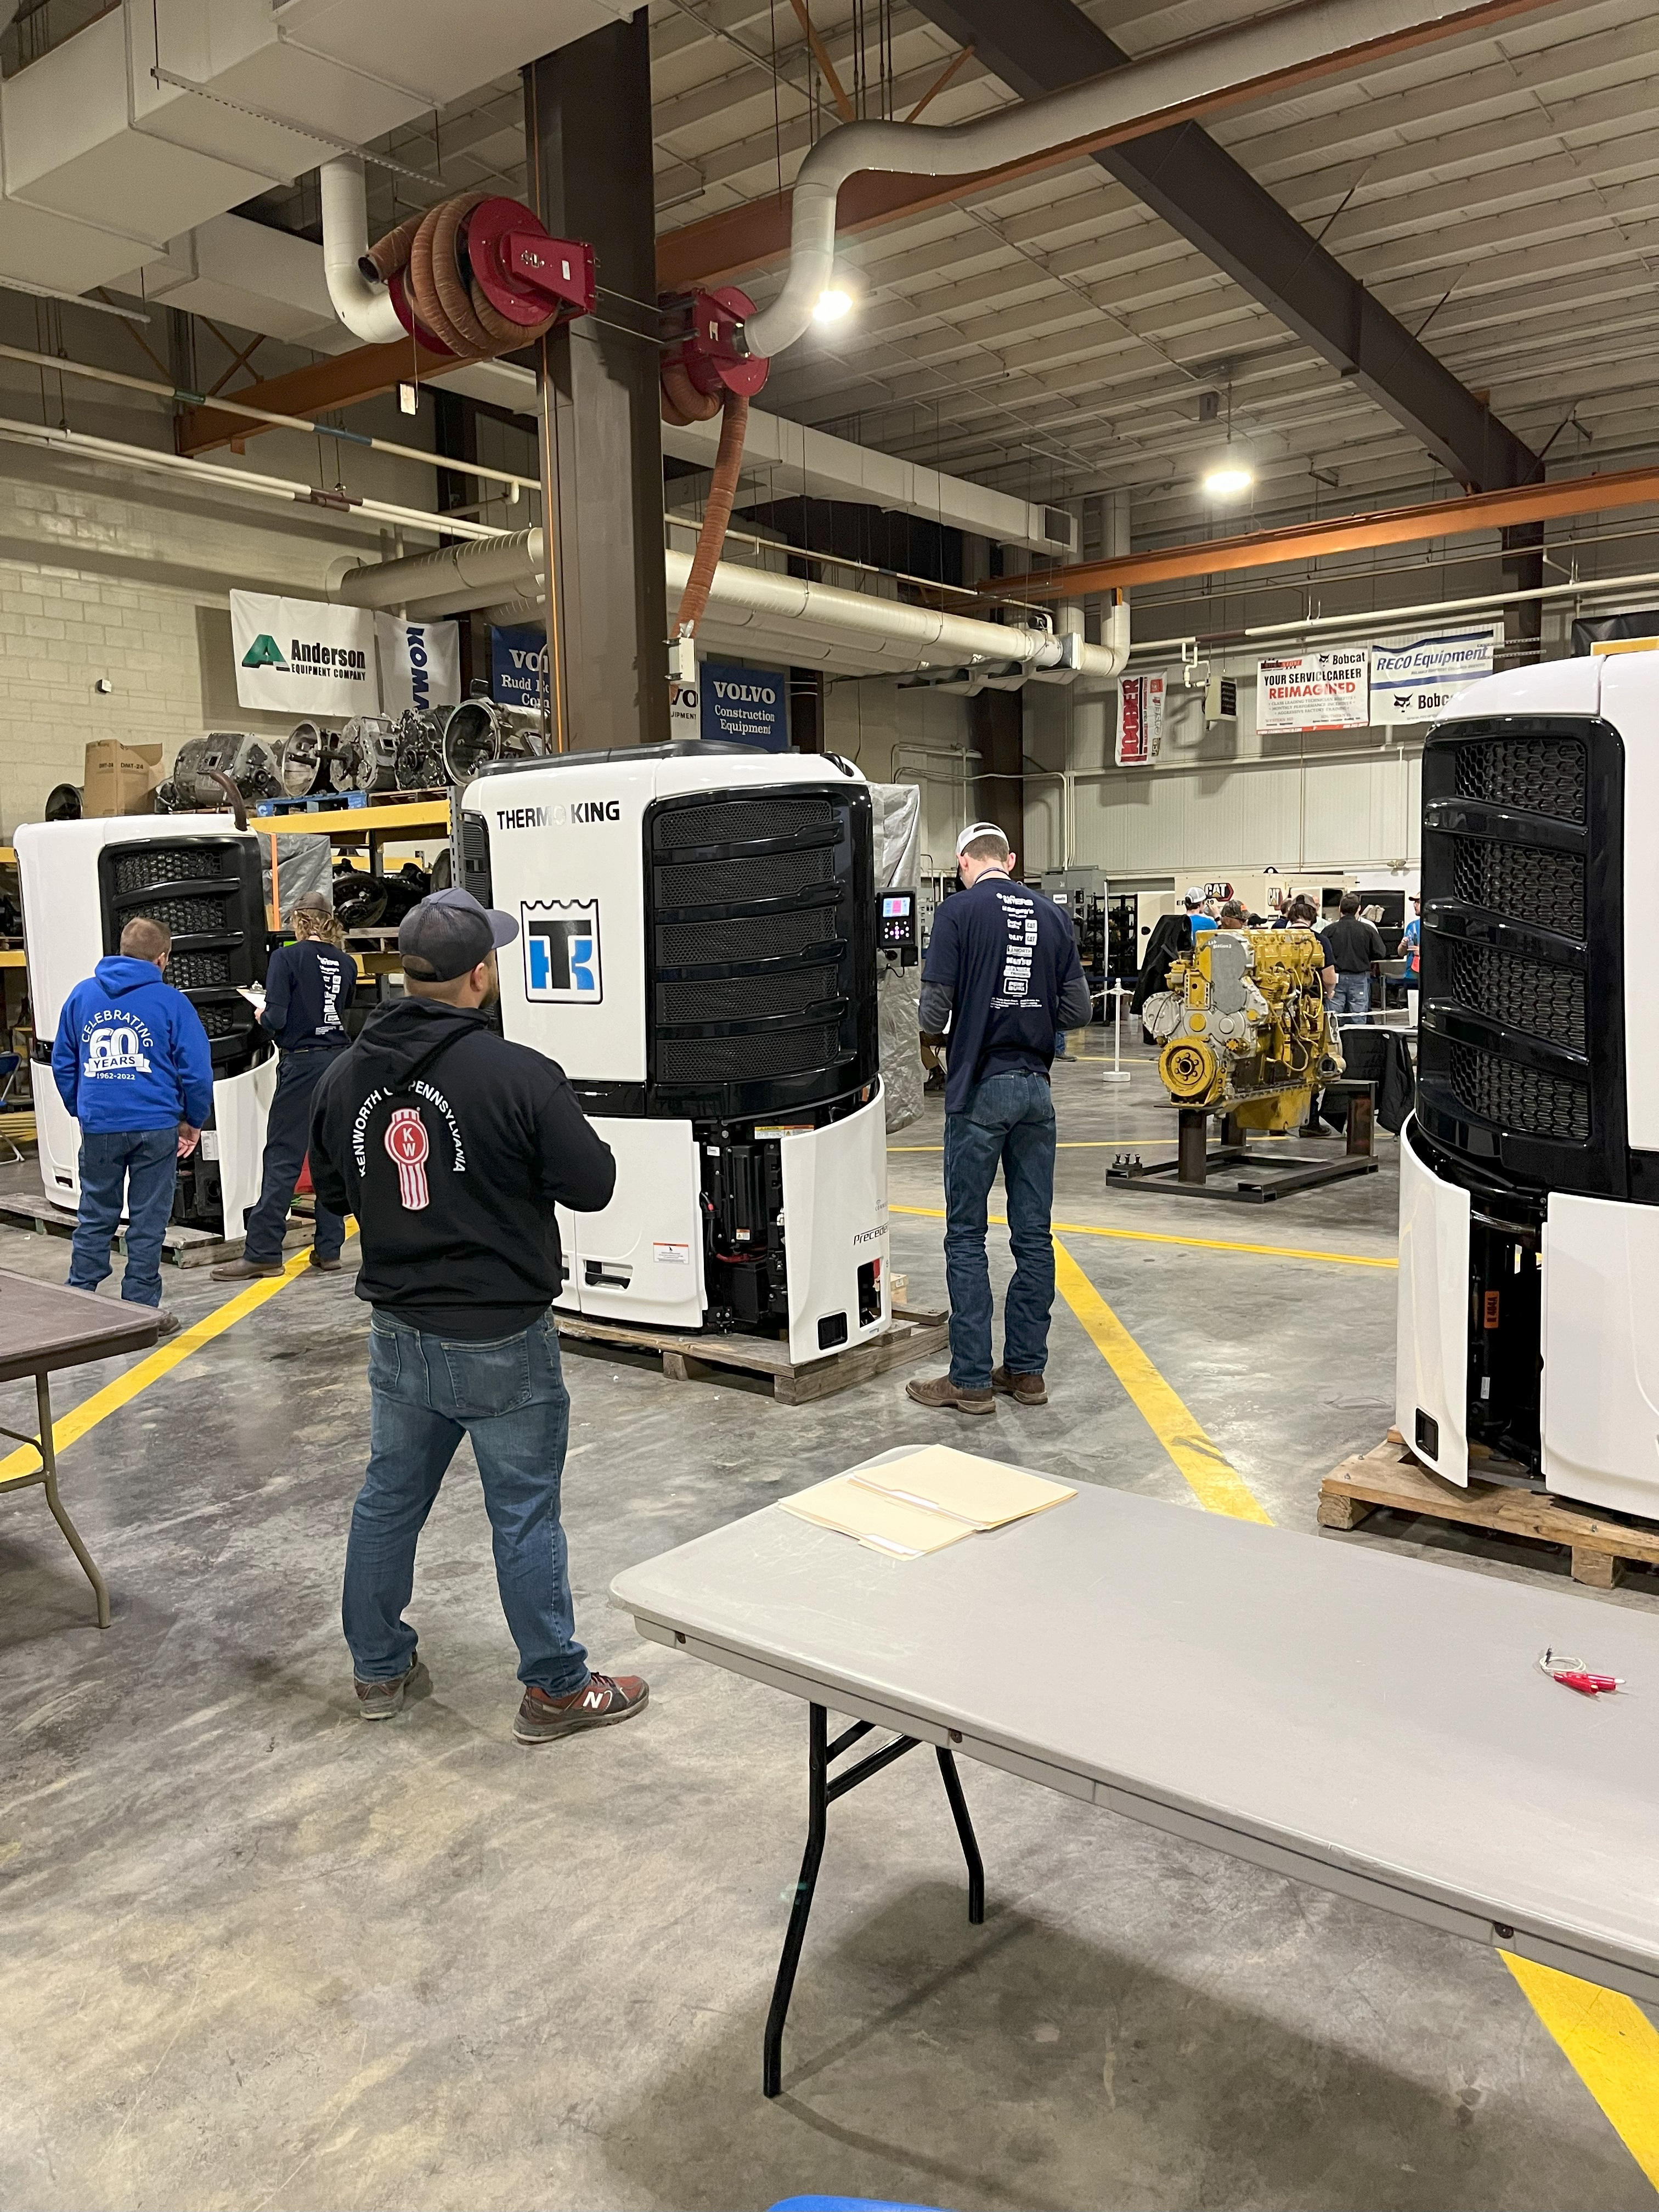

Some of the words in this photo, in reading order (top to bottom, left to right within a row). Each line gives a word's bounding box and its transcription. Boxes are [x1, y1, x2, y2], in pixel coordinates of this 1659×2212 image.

[291, 639, 366, 669] Anderson
[1333, 652, 1365, 665] Bobcat
[1376, 656, 1412, 671] RECO
[1413, 645, 1488, 668] Equipment
[291, 663, 330, 677] EQUIPMENT
[334, 668, 366, 681] COMPANY
[1264, 674, 1286, 686] YOUR
[1327, 668, 1361, 681] CAREER
[501, 674, 532, 691] Rudd
[1269, 681, 1356, 699] REIMAGINED
[713, 681, 776, 704] VOLVO
[715, 704, 775, 722] Construction
[720, 718, 771, 735] Equipment
[571, 800, 620, 823] KING
[1205, 883, 1227, 898] CAT
[1268, 888, 1279, 905] CAT
[82, 1009, 153, 1047] CELEBRATING
[89, 1026, 139, 1058] 60
[94, 1057, 136, 1069] YEARS
[353, 1090, 382, 1177] KENWORTH
